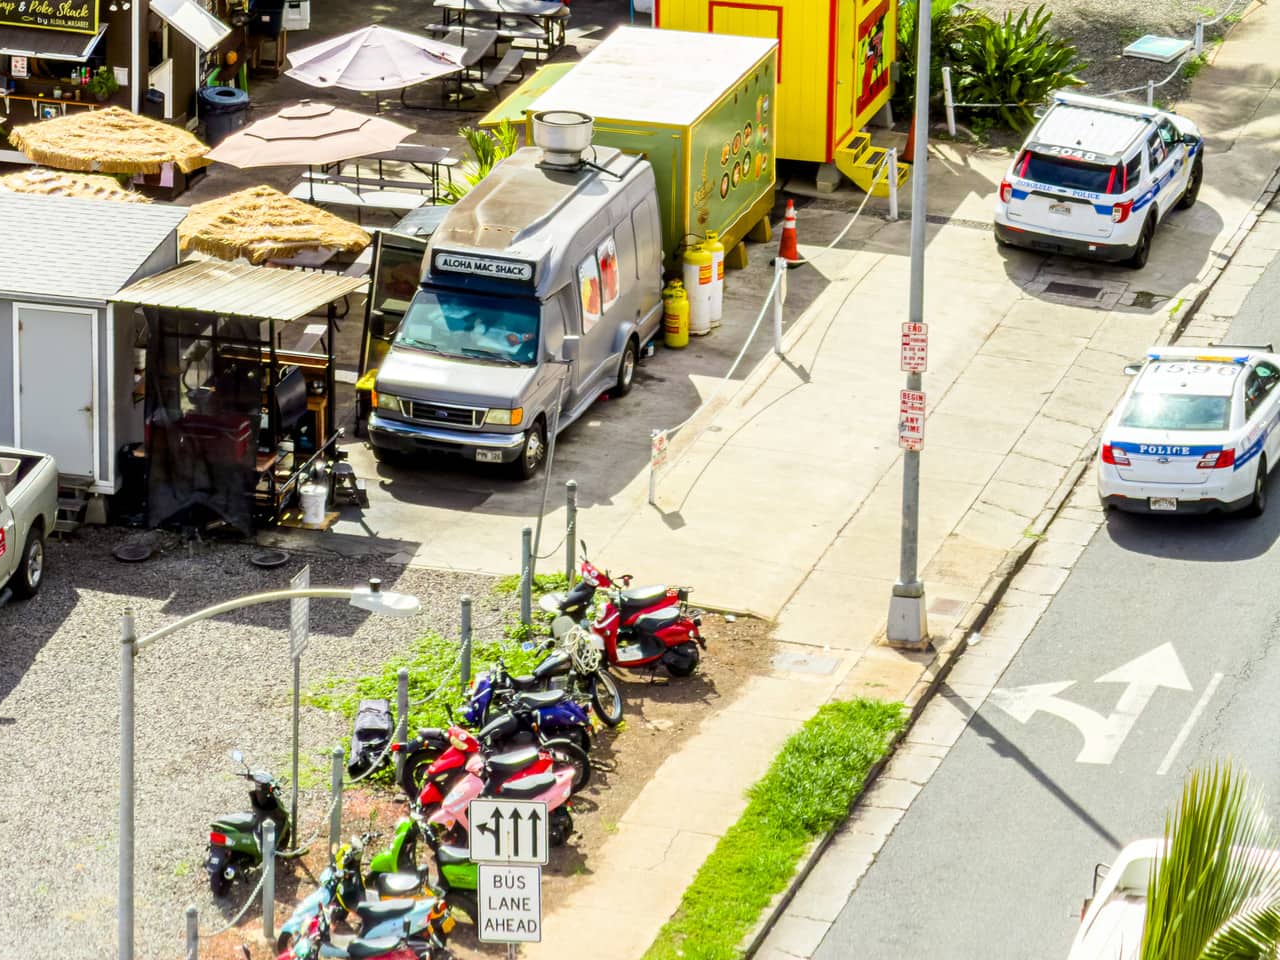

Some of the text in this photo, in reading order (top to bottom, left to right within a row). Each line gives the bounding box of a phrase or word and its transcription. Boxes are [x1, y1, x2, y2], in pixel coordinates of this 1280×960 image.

[18, 2, 27, 13] &
[28, 0, 55, 16] Poke
[56, 0, 89, 18] Shack
[37, 17, 49, 25] by
[1051, 146, 1097, 161] 2048
[1072, 189, 1101, 201] POLICE
[442, 258, 526, 276] ALOHA MAC SHACK
[902, 392, 923, 401] BEGIN
[1139, 444, 1191, 455] POLICE
[493, 874, 526, 890] BUS
[488, 896, 532, 911] LANE
[484, 917, 538, 933] AHEAD
